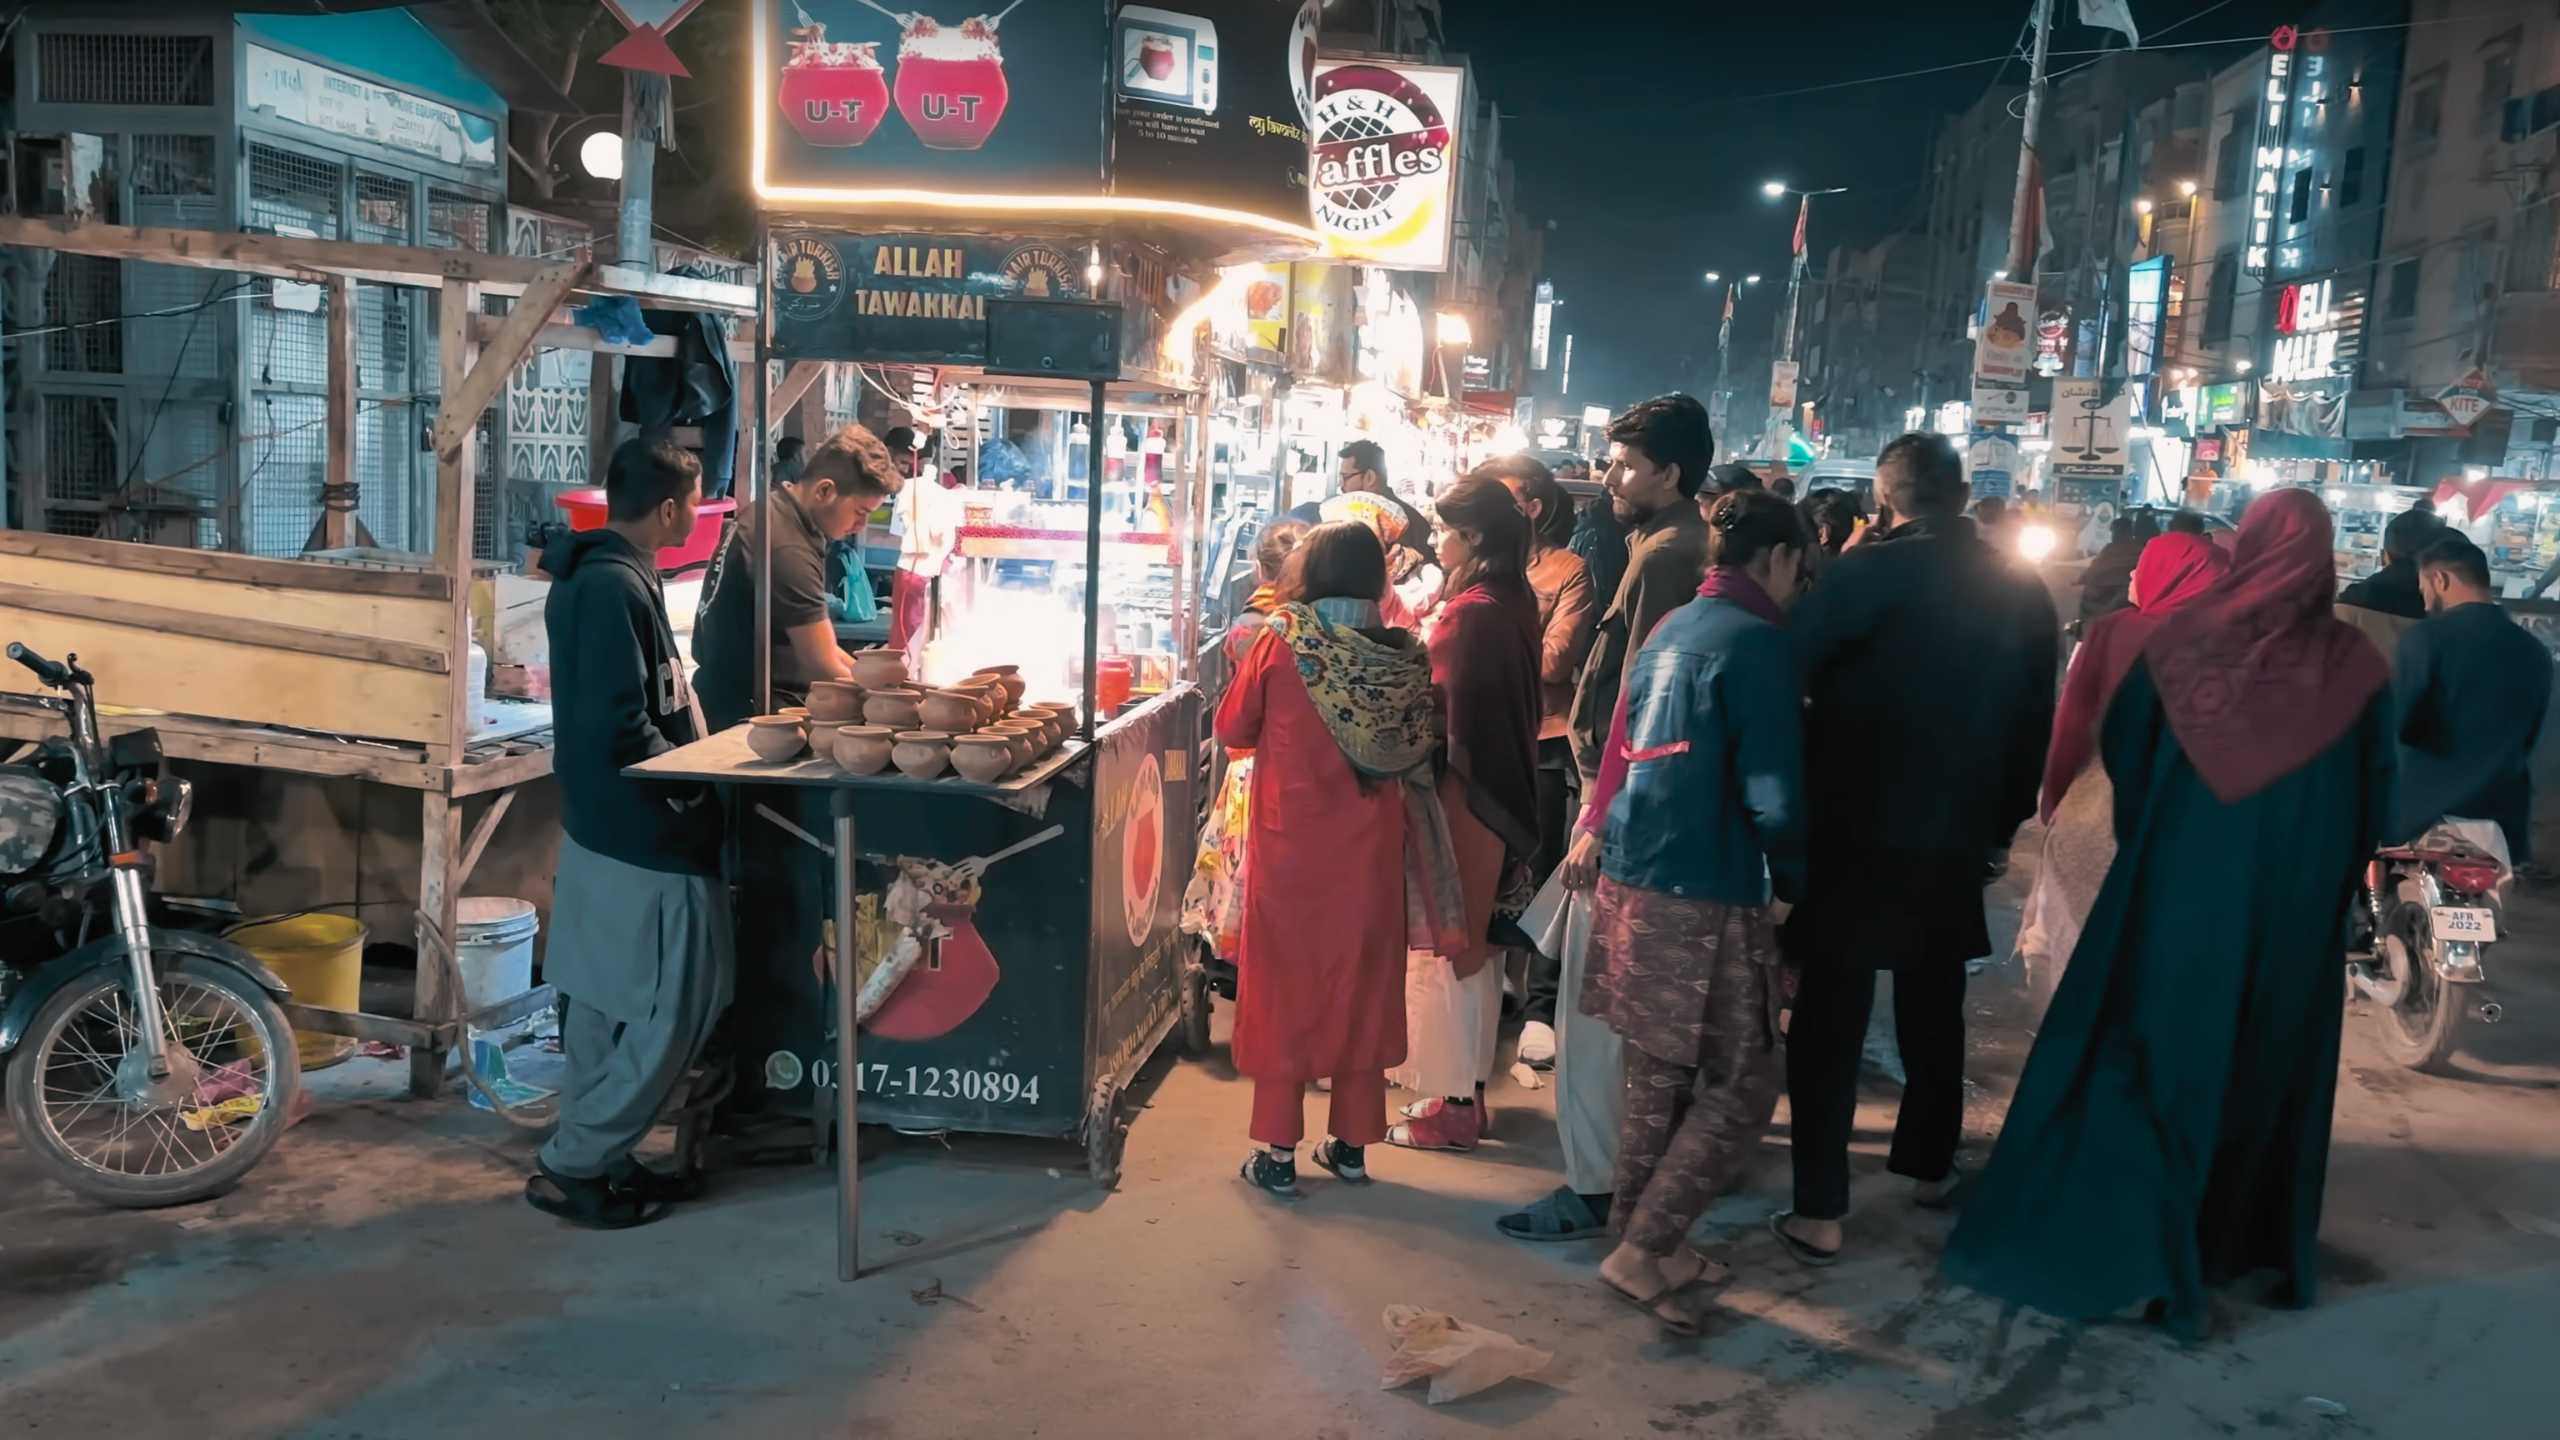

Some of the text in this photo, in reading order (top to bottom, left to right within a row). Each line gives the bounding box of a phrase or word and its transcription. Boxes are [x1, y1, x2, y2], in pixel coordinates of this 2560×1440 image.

[805, 100, 863, 123] U-T
[921, 93, 983, 121] U-T
[1316, 102, 1338, 124] H
[1346, 95, 1366, 111] &
[1374, 99, 1397, 119] H
[1315, 204, 1394, 231] NIGHT
[2247, 146, 2283, 268] MALIK
[873, 246, 963, 279] ALLAH
[855, 289, 987, 320] TAWAKKAL
[2450, 399, 2479, 413] KITE
[2448, 920, 2482, 931] 2022
